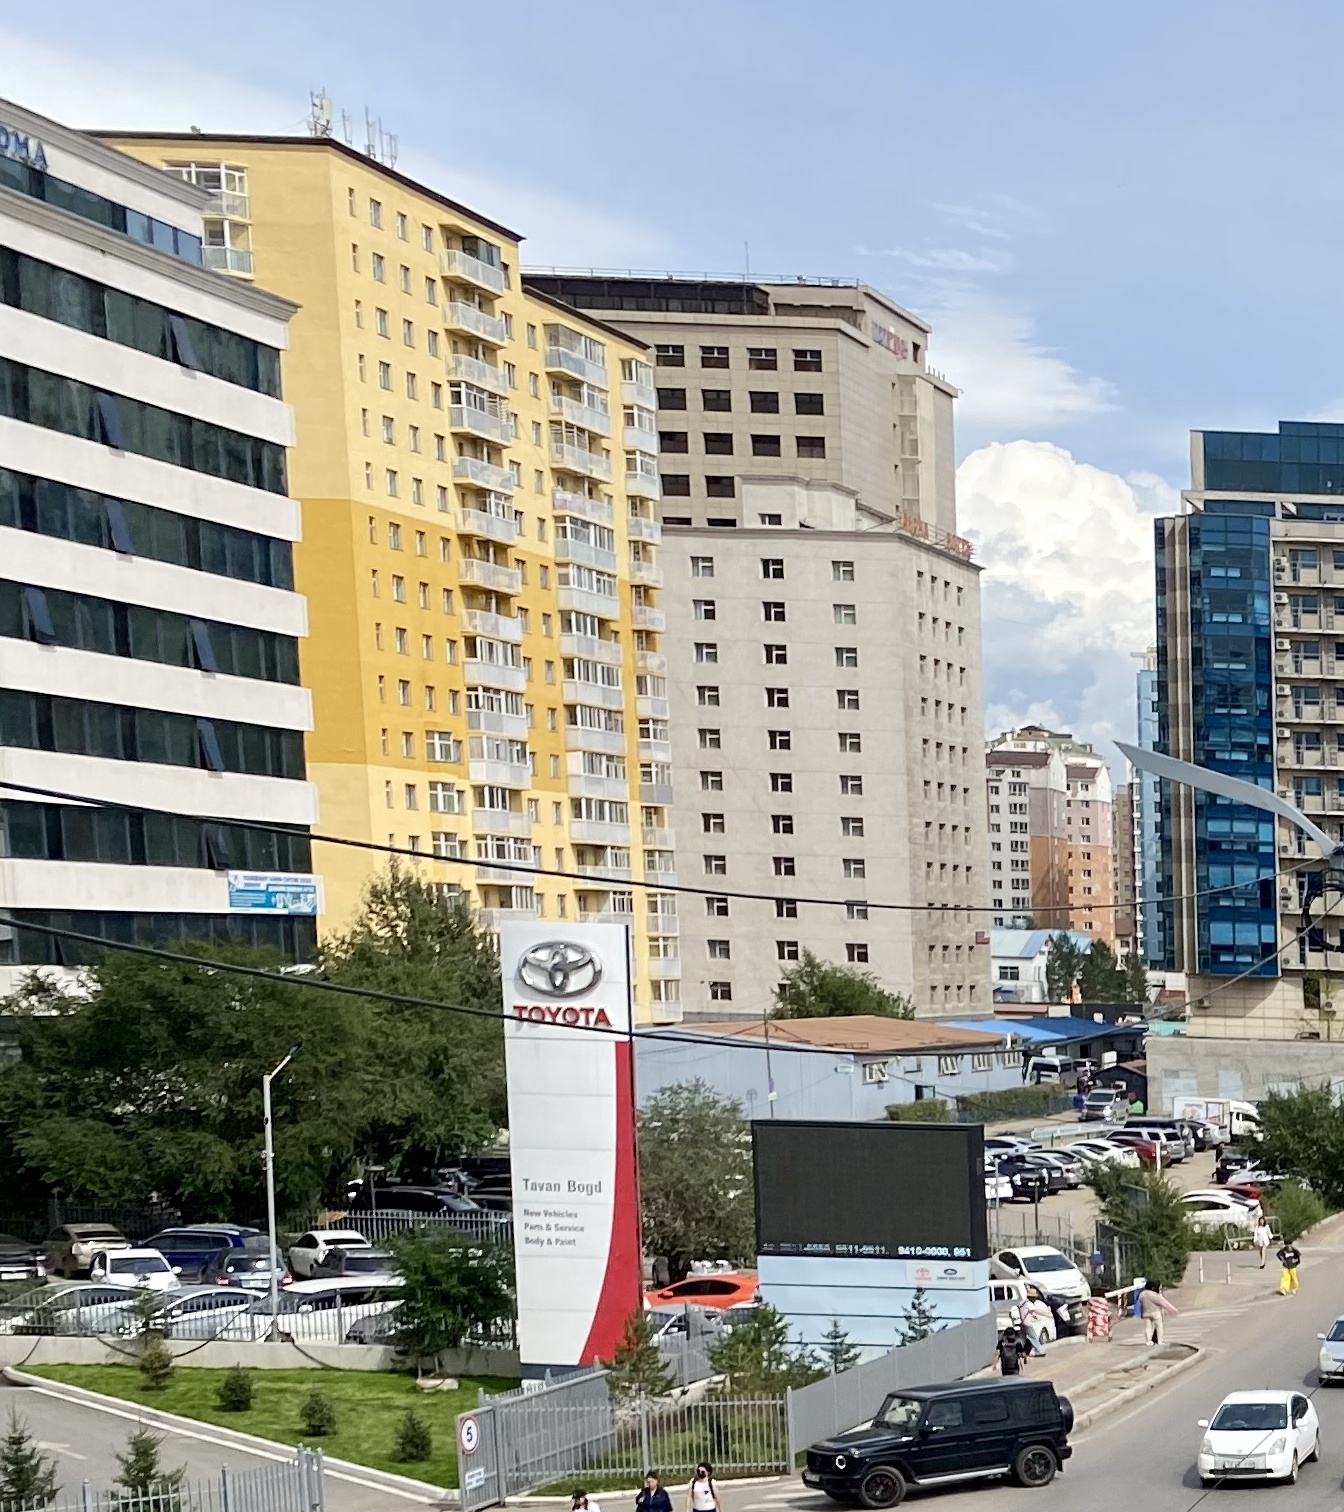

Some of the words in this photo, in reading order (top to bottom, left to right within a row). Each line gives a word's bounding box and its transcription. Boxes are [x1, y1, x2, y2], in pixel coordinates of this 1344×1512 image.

[513, 1005, 613, 1028] TOYOTA
[522, 1178, 561, 1192] Tavan
[567, 1180, 602, 1196] Bogd
[523, 1208, 541, 1217] New
[543, 1209, 578, 1219] Vehicles
[554, 1223, 585, 1232] Service
[524, 1236, 545, 1247] Body
[555, 1238, 577, 1246] Paint
[466, 1426, 473, 1443] 5
